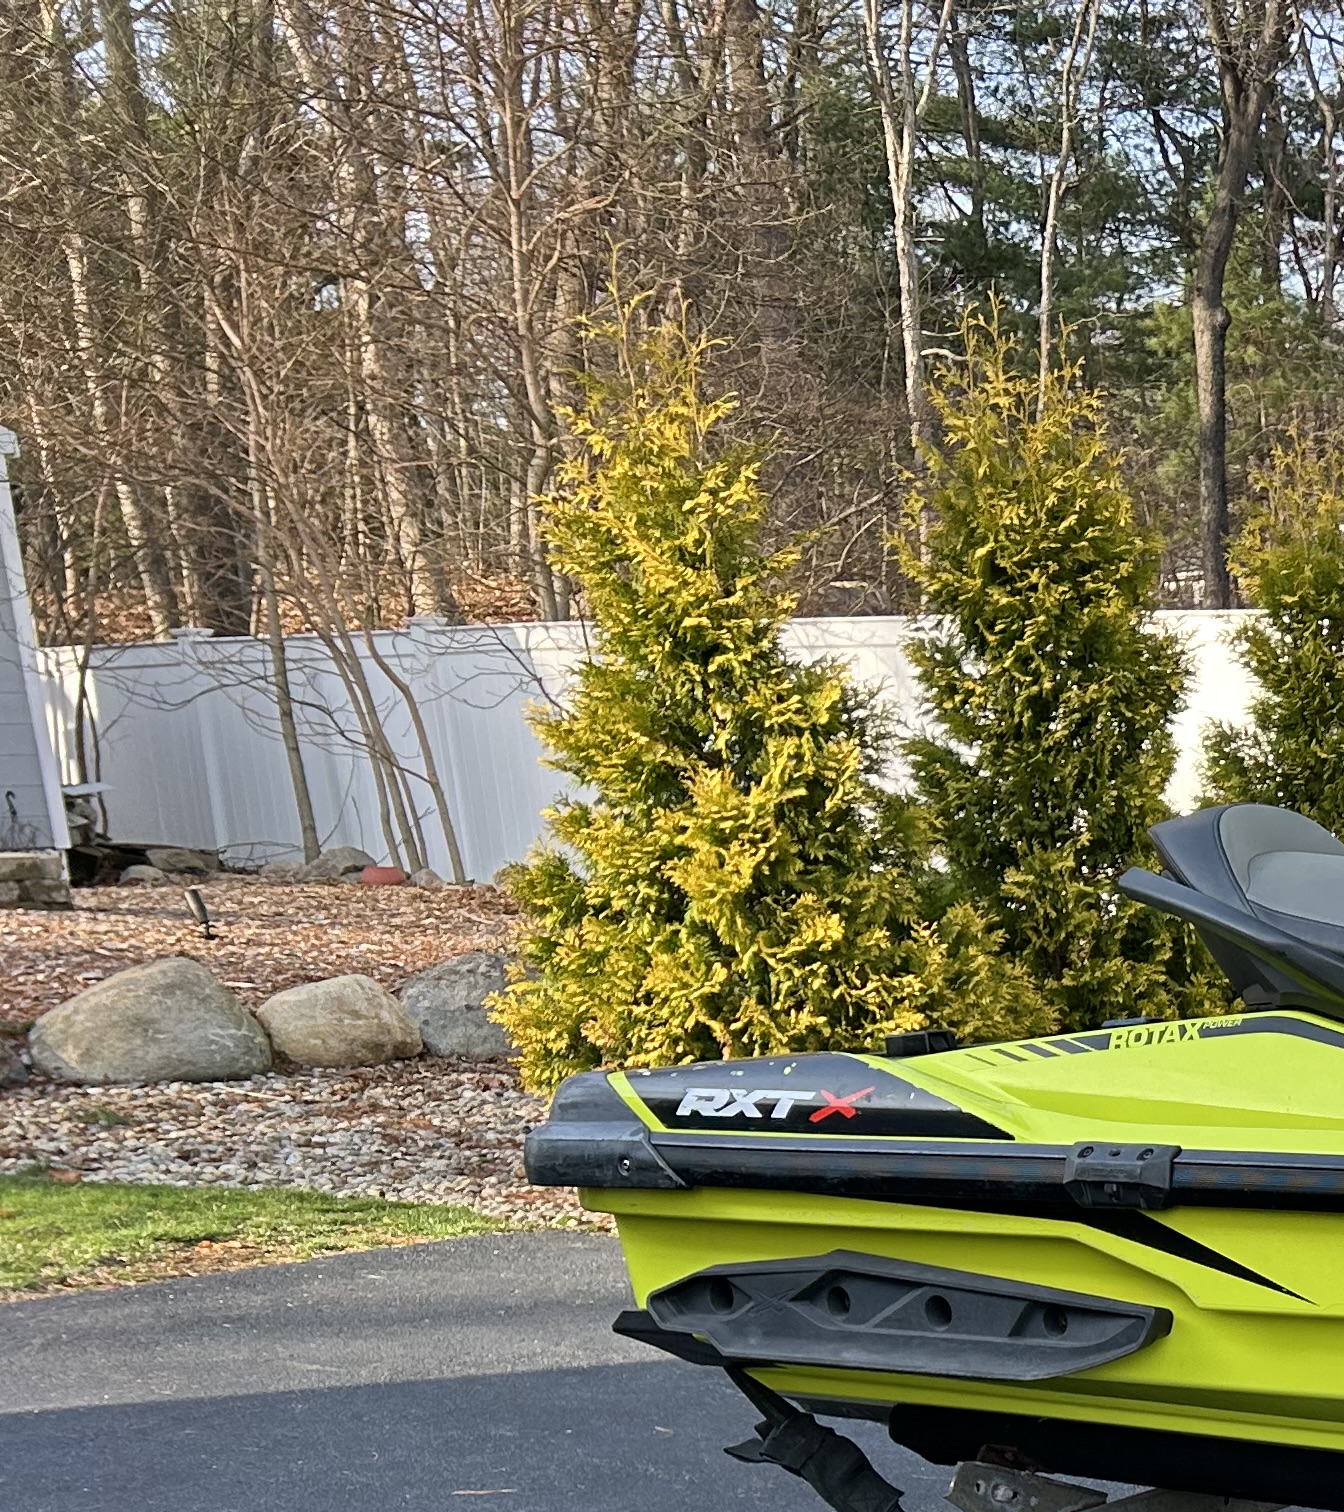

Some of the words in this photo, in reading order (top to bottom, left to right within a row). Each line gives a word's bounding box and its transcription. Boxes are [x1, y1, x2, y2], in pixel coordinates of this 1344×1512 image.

[1108, 1022, 1201, 1051] ROTAX
[1202, 1018, 1243, 1030] POWER
[675, 1087, 817, 1119] RXT
[808, 1086, 876, 1124] X
